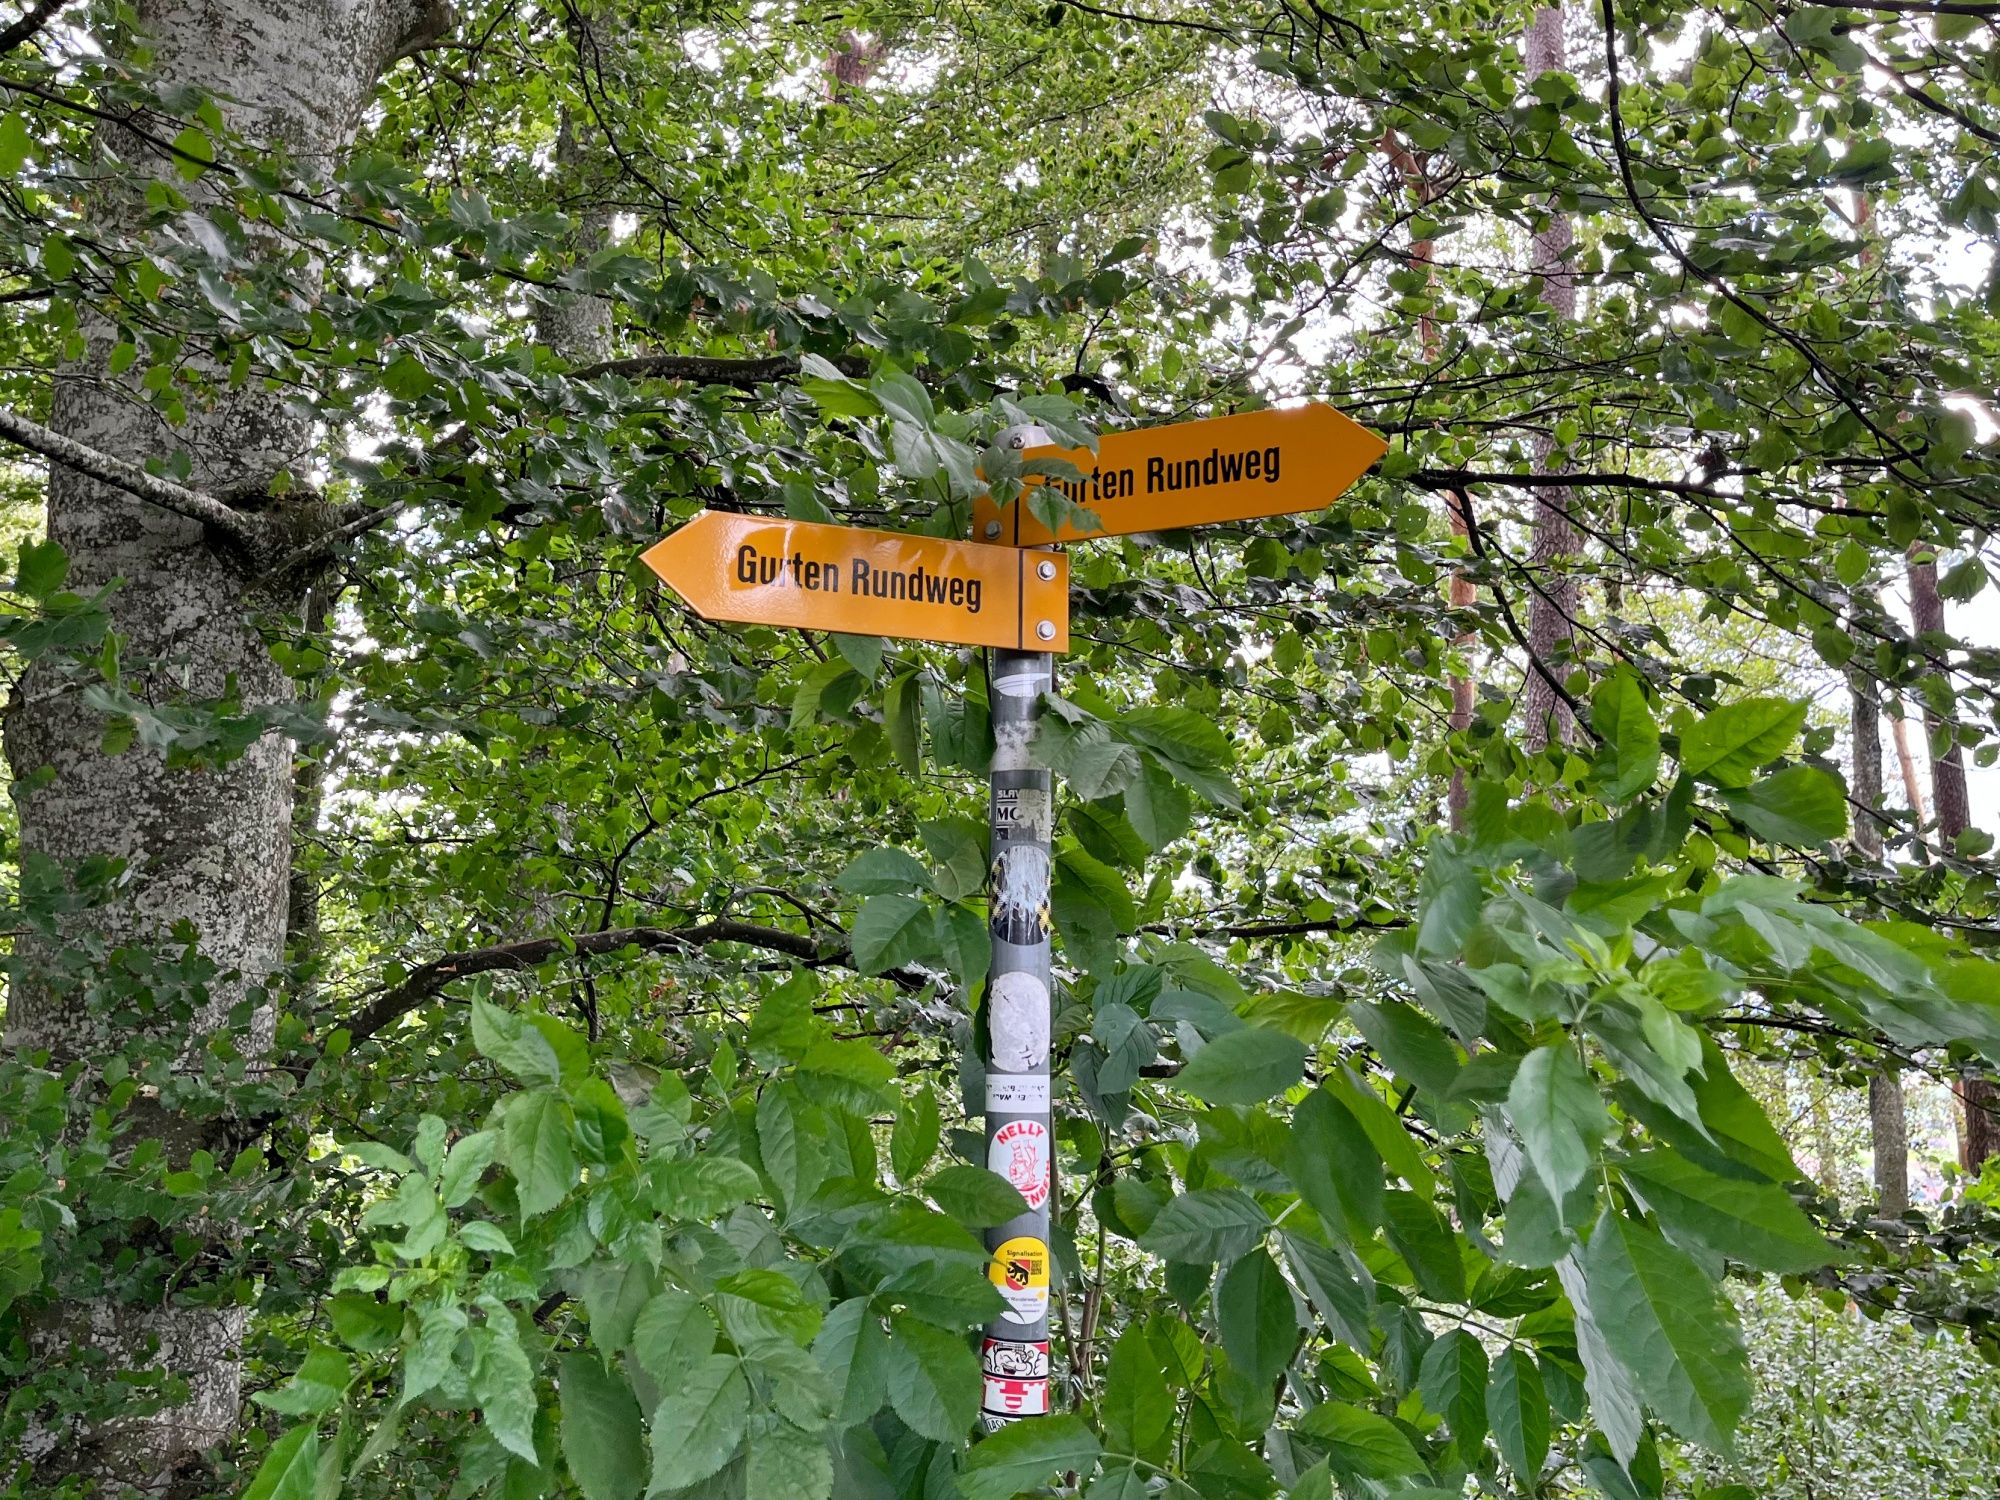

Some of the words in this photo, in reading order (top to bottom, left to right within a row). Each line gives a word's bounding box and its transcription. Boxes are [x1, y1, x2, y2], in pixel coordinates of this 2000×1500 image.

[1147, 446, 1280, 494] Rundweg
[737, 545, 839, 592] Gurten
[852, 558, 982, 614] Rundweg
[996, 1123, 1043, 1144] NELLY
